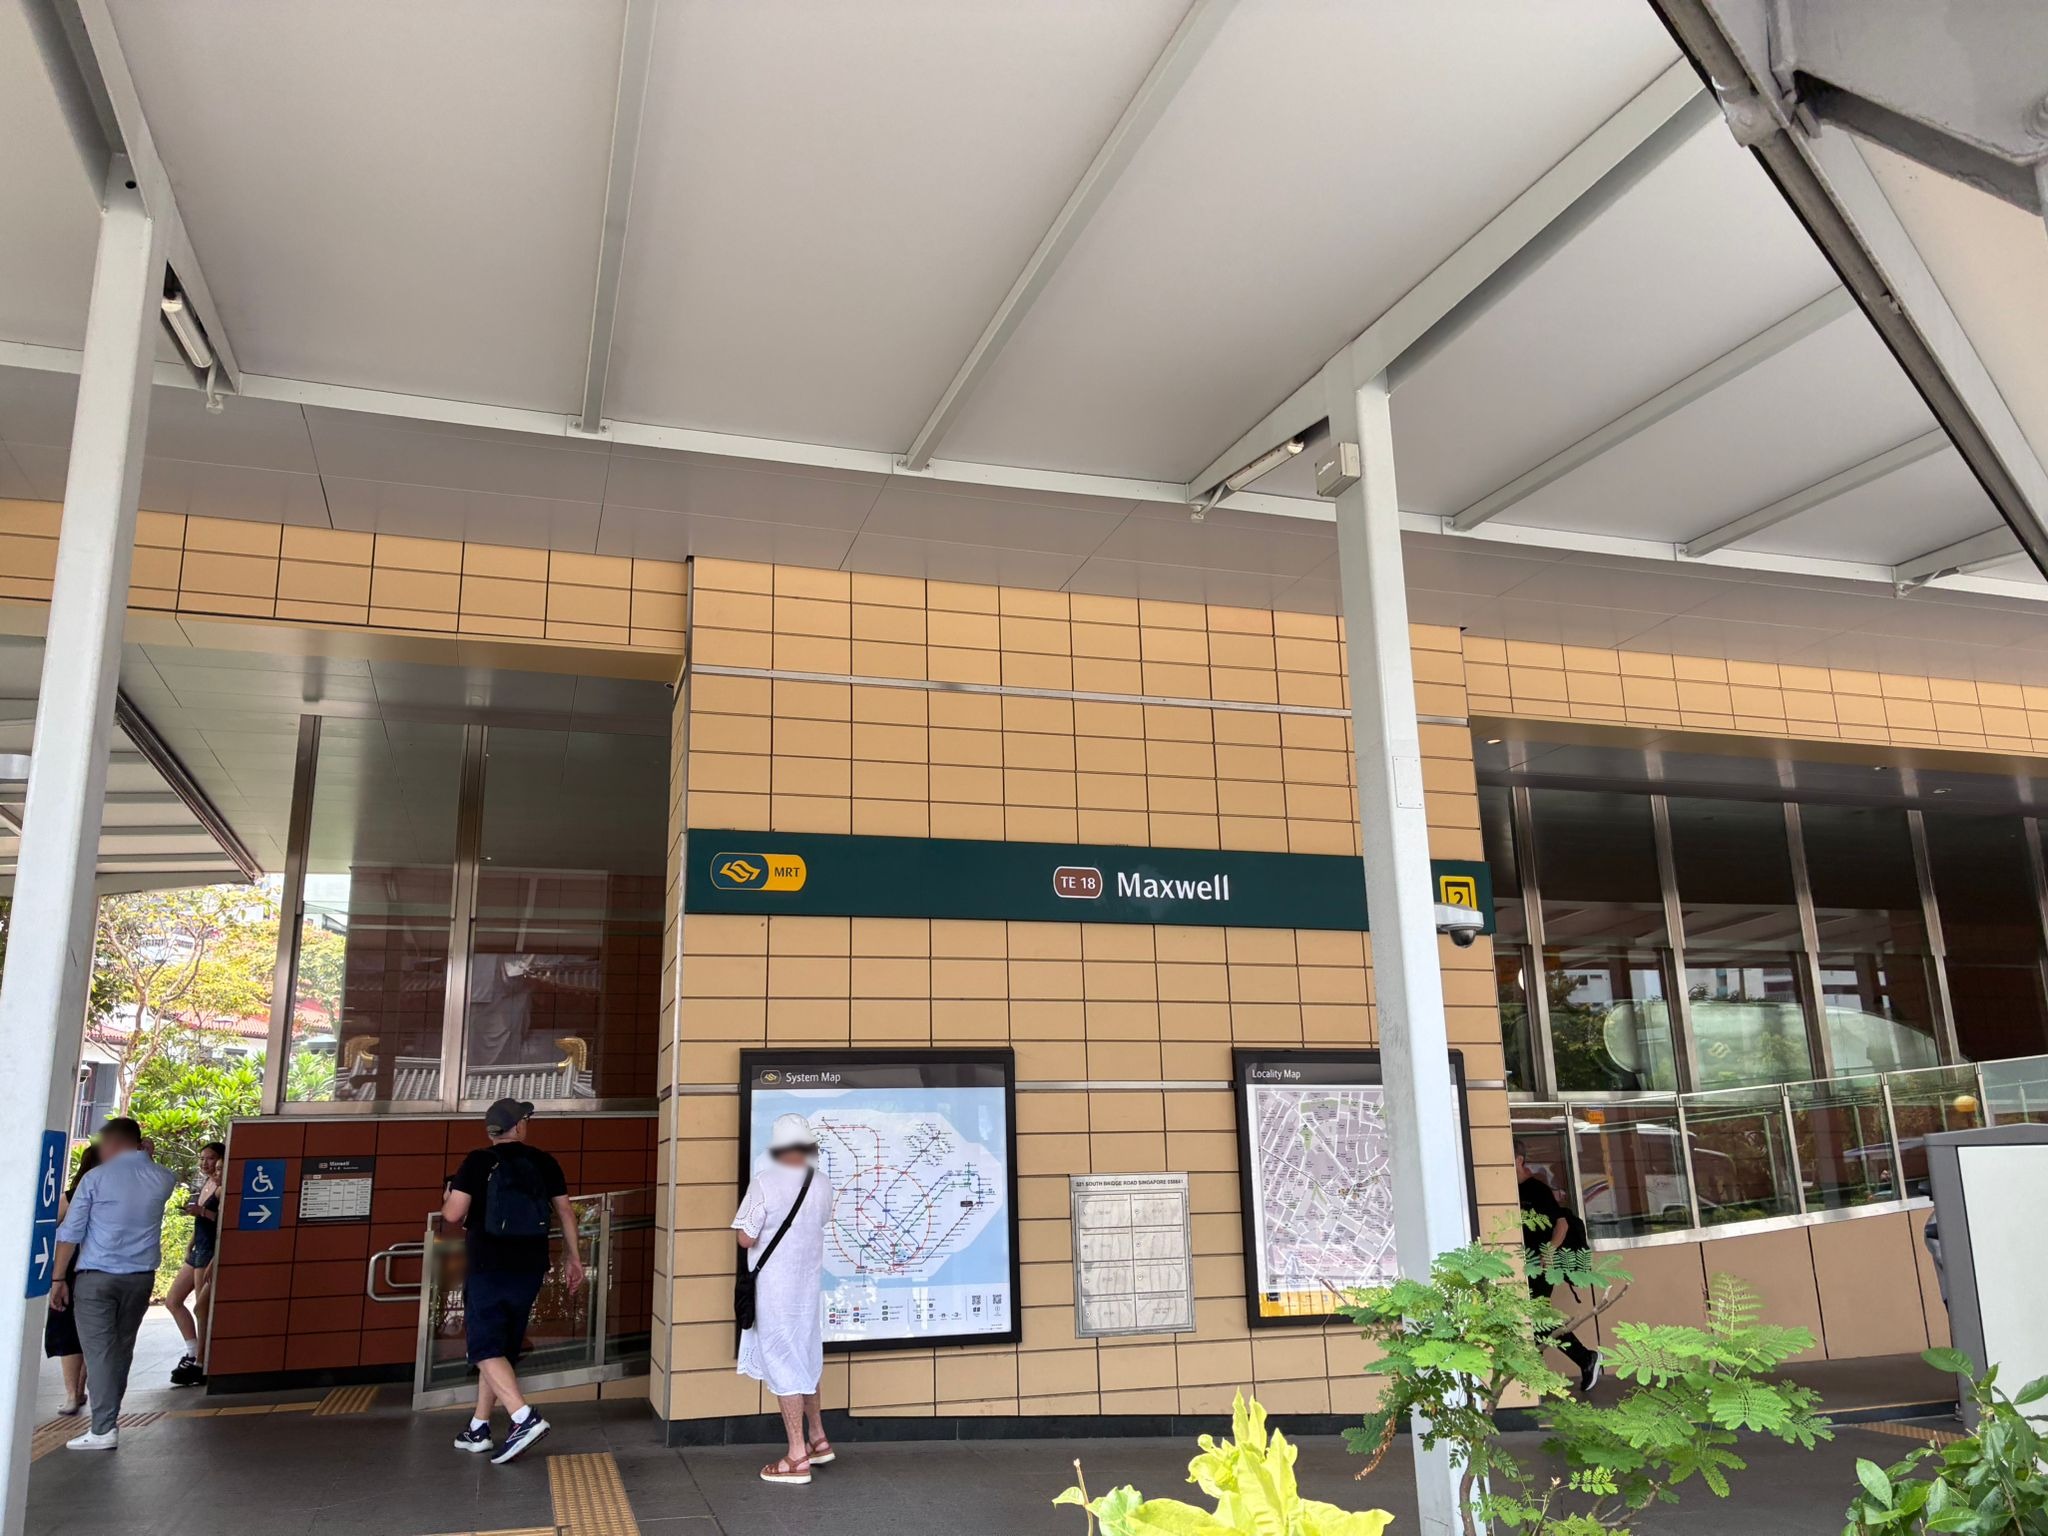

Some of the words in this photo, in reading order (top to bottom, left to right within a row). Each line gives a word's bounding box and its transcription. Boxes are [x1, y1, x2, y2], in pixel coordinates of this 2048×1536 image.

[774, 866, 800, 878] MRT
[1060, 876, 1076, 889] TE
[1081, 877, 1096, 890] 18
[1117, 872, 1230, 901] Maxwell
[1453, 891, 1464, 905] 2
[785, 1072, 819, 1085] System
[821, 1072, 841, 1084] Map
[1252, 1069, 1282, 1080] Locality
[1283, 1069, 1301, 1080] Map
